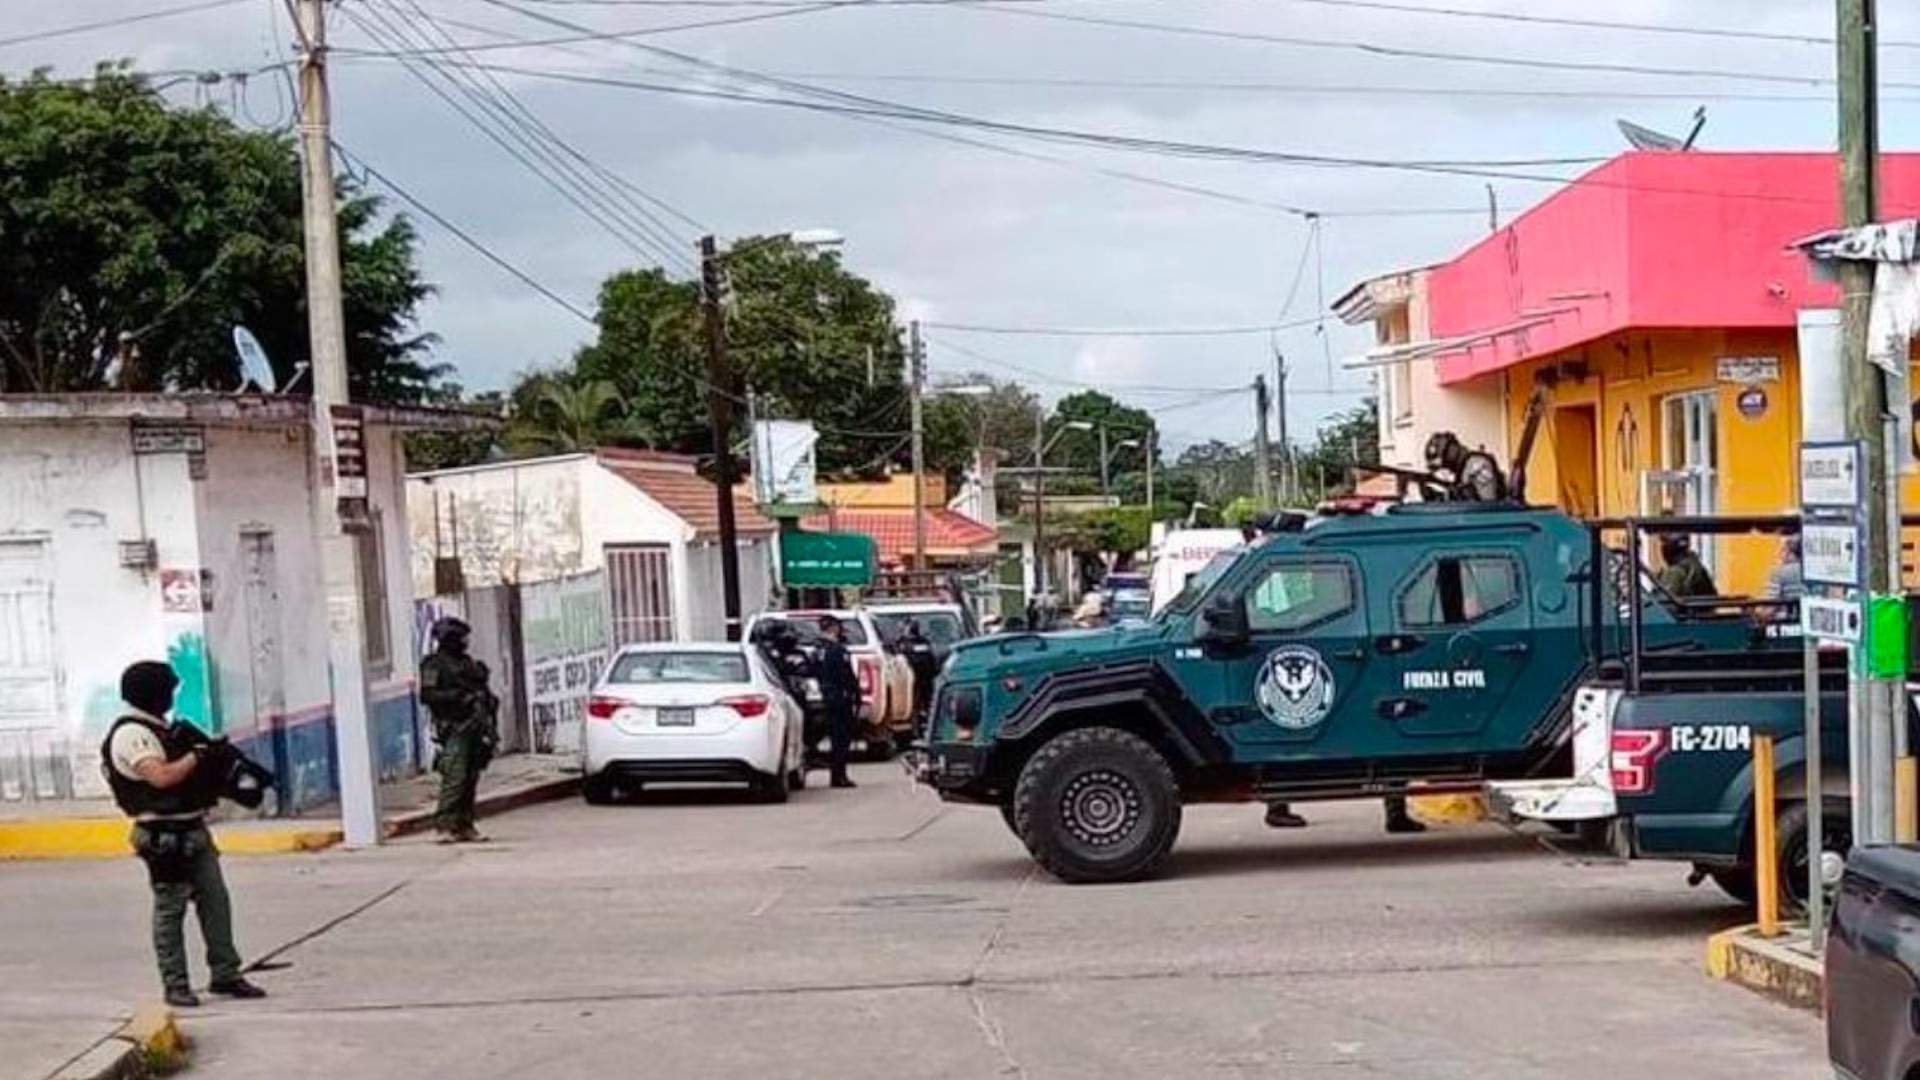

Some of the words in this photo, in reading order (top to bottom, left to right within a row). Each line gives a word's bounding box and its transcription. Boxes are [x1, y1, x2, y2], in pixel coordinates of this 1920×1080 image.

[1402, 671, 1450, 690] FUERZA
[1453, 669, 1486, 688] CIVIL
[1671, 724, 1751, 751] FC-2704
